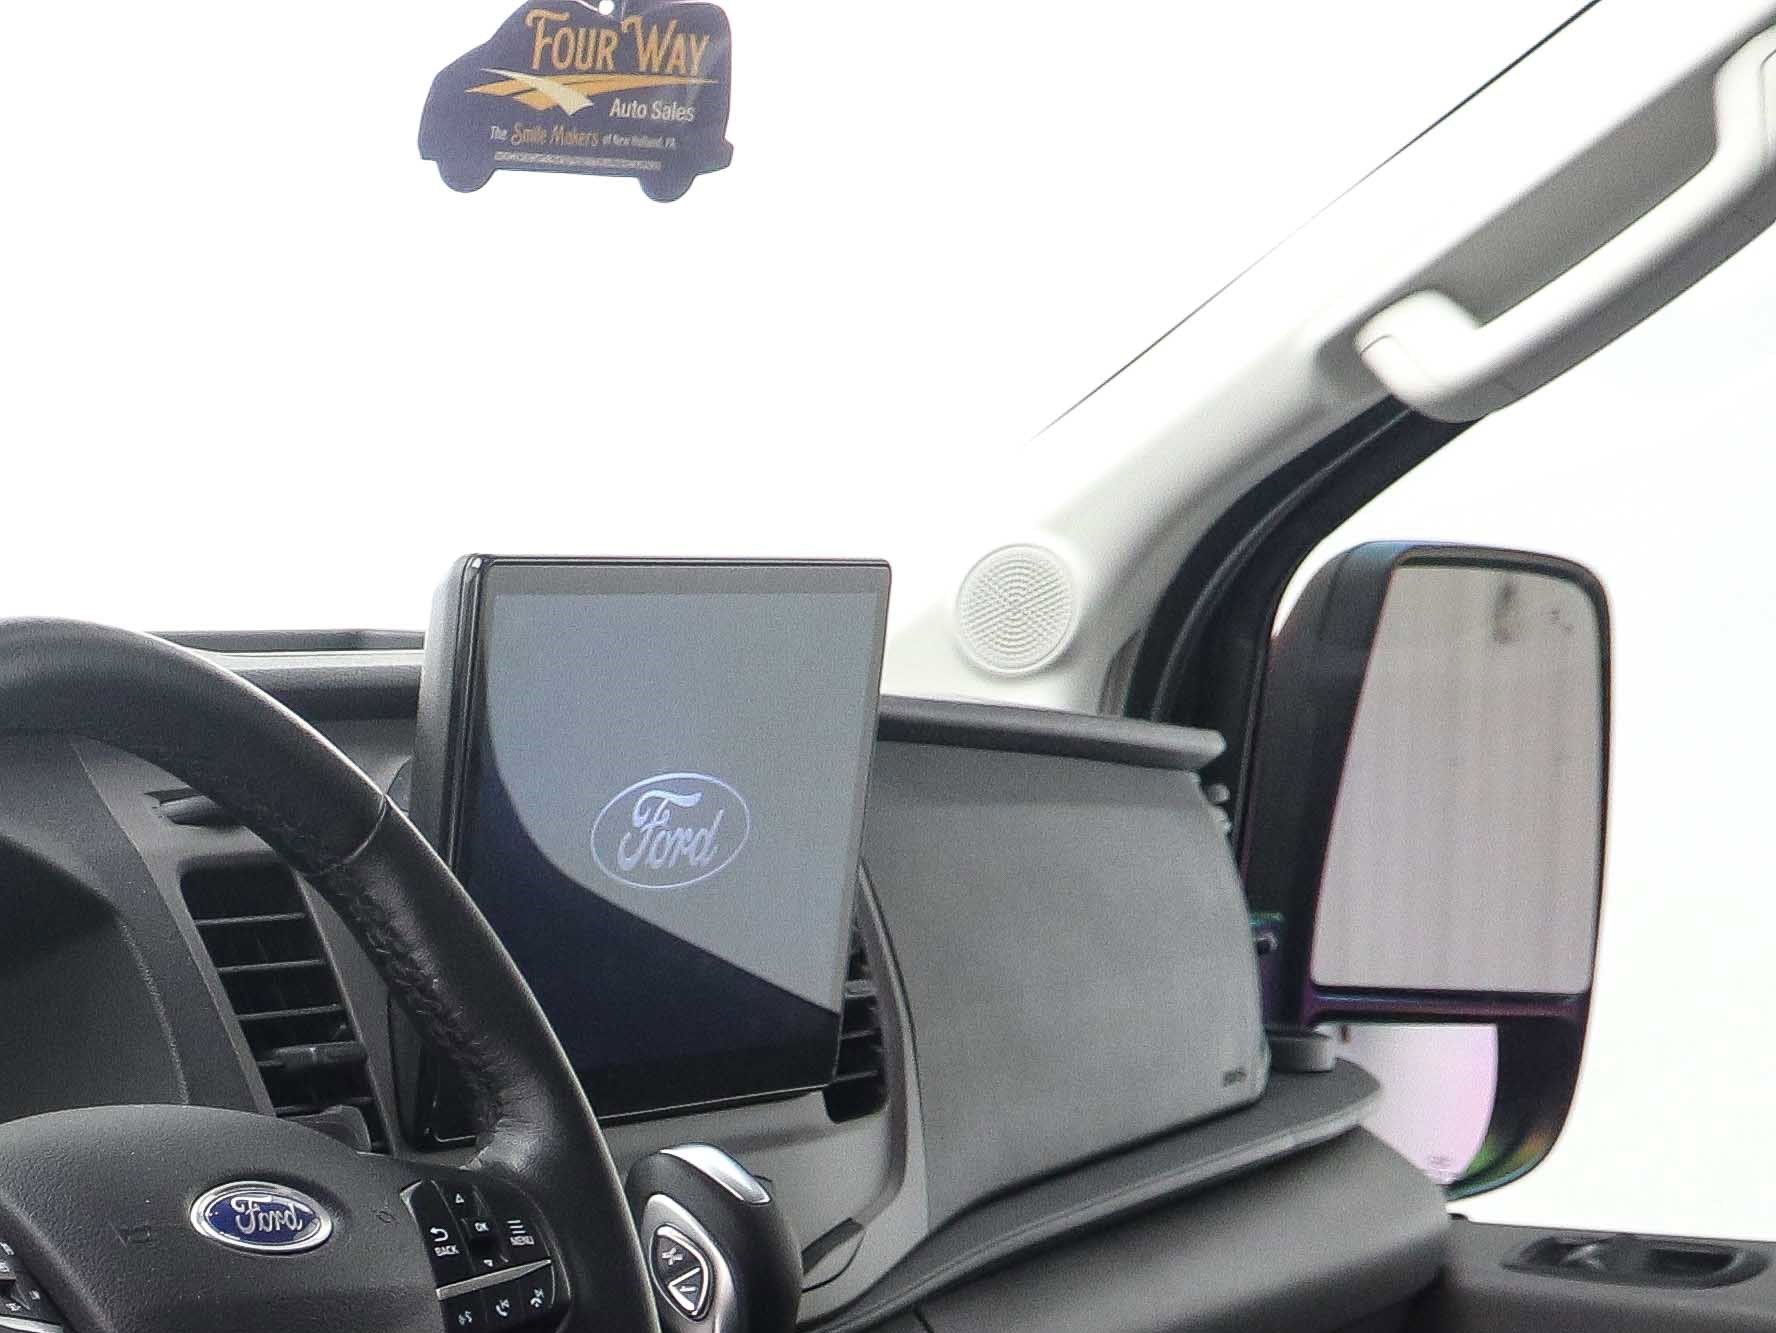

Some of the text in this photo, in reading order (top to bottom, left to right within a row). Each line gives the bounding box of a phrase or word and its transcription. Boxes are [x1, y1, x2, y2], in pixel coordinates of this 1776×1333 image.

[609, 97, 697, 122] Auto Sales
[616, 788, 724, 872] Ford
[230, 1193, 305, 1235] Ford
[474, 1222, 489, 1232] OK
[434, 1245, 460, 1257] BACK
